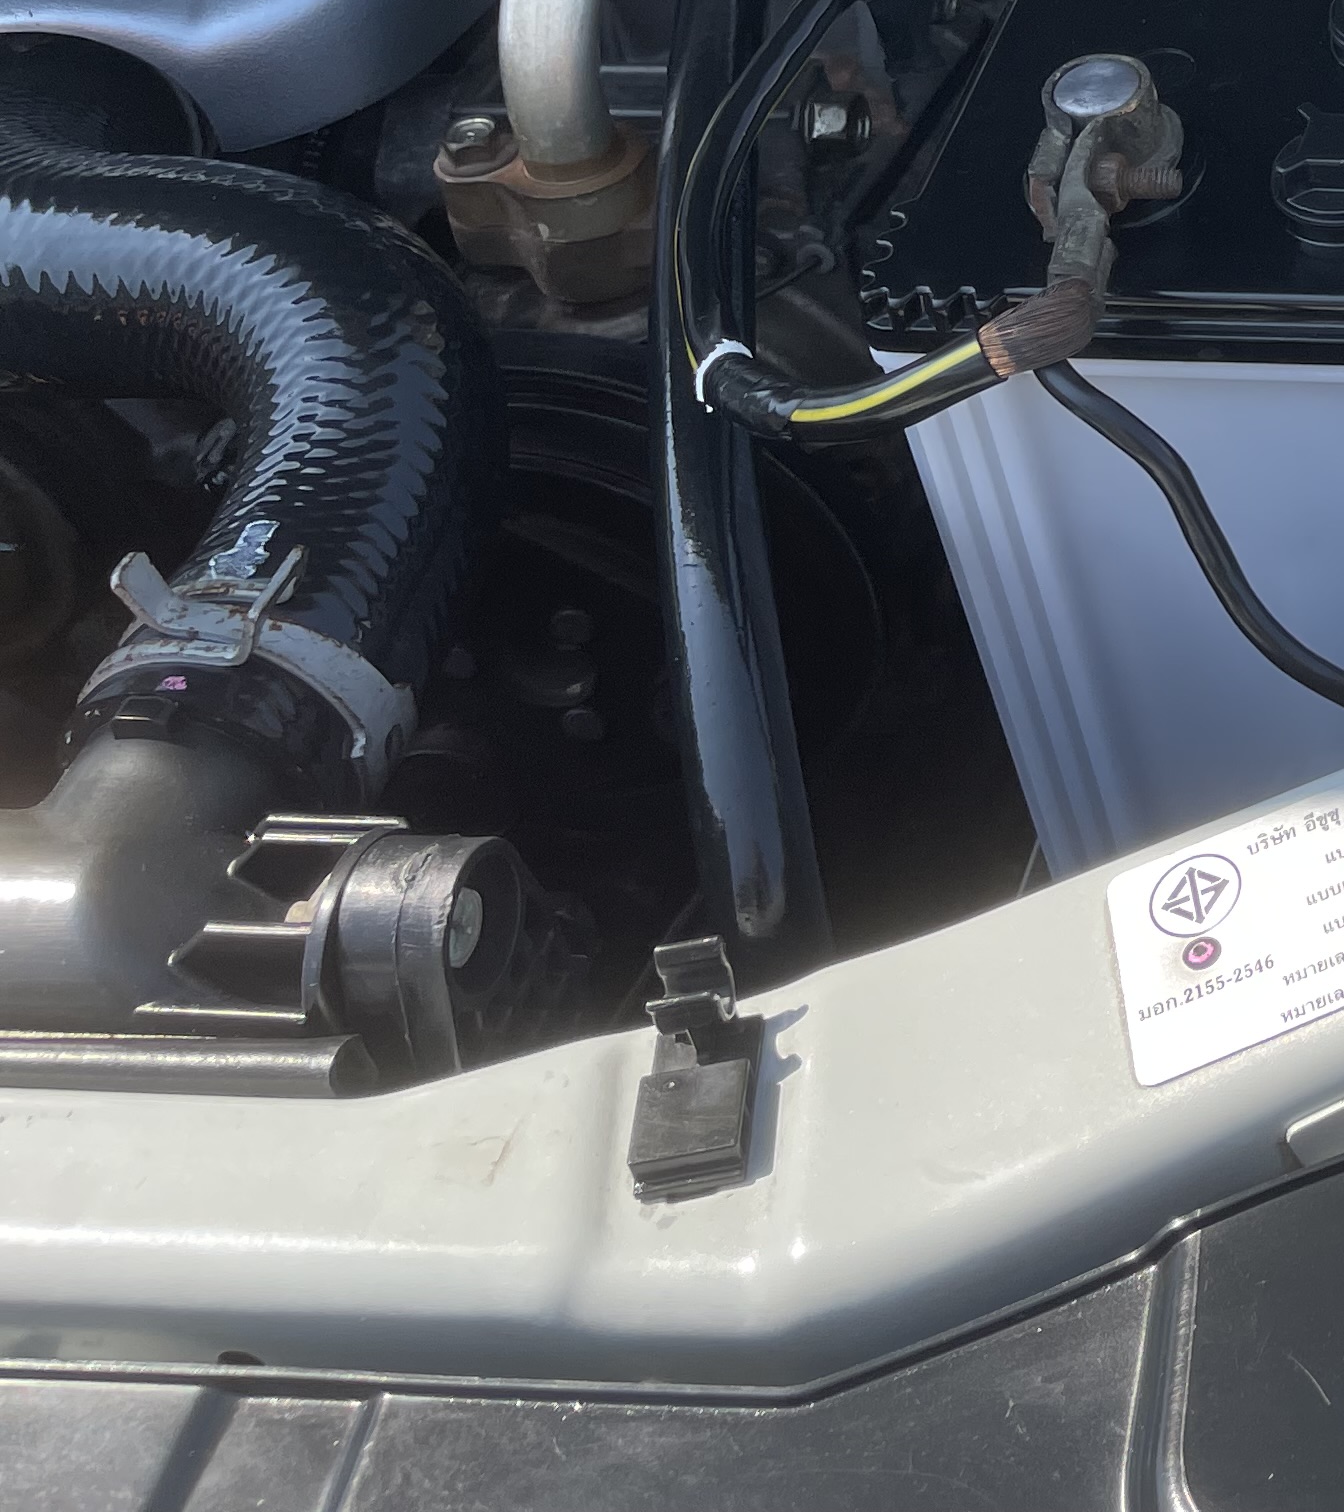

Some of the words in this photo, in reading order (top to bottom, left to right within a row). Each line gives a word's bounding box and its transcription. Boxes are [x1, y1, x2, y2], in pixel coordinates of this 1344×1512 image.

[1246, 824, 1297, 856] บริษัท
[1138, 953, 1275, 1022] มอก.2155-2546
